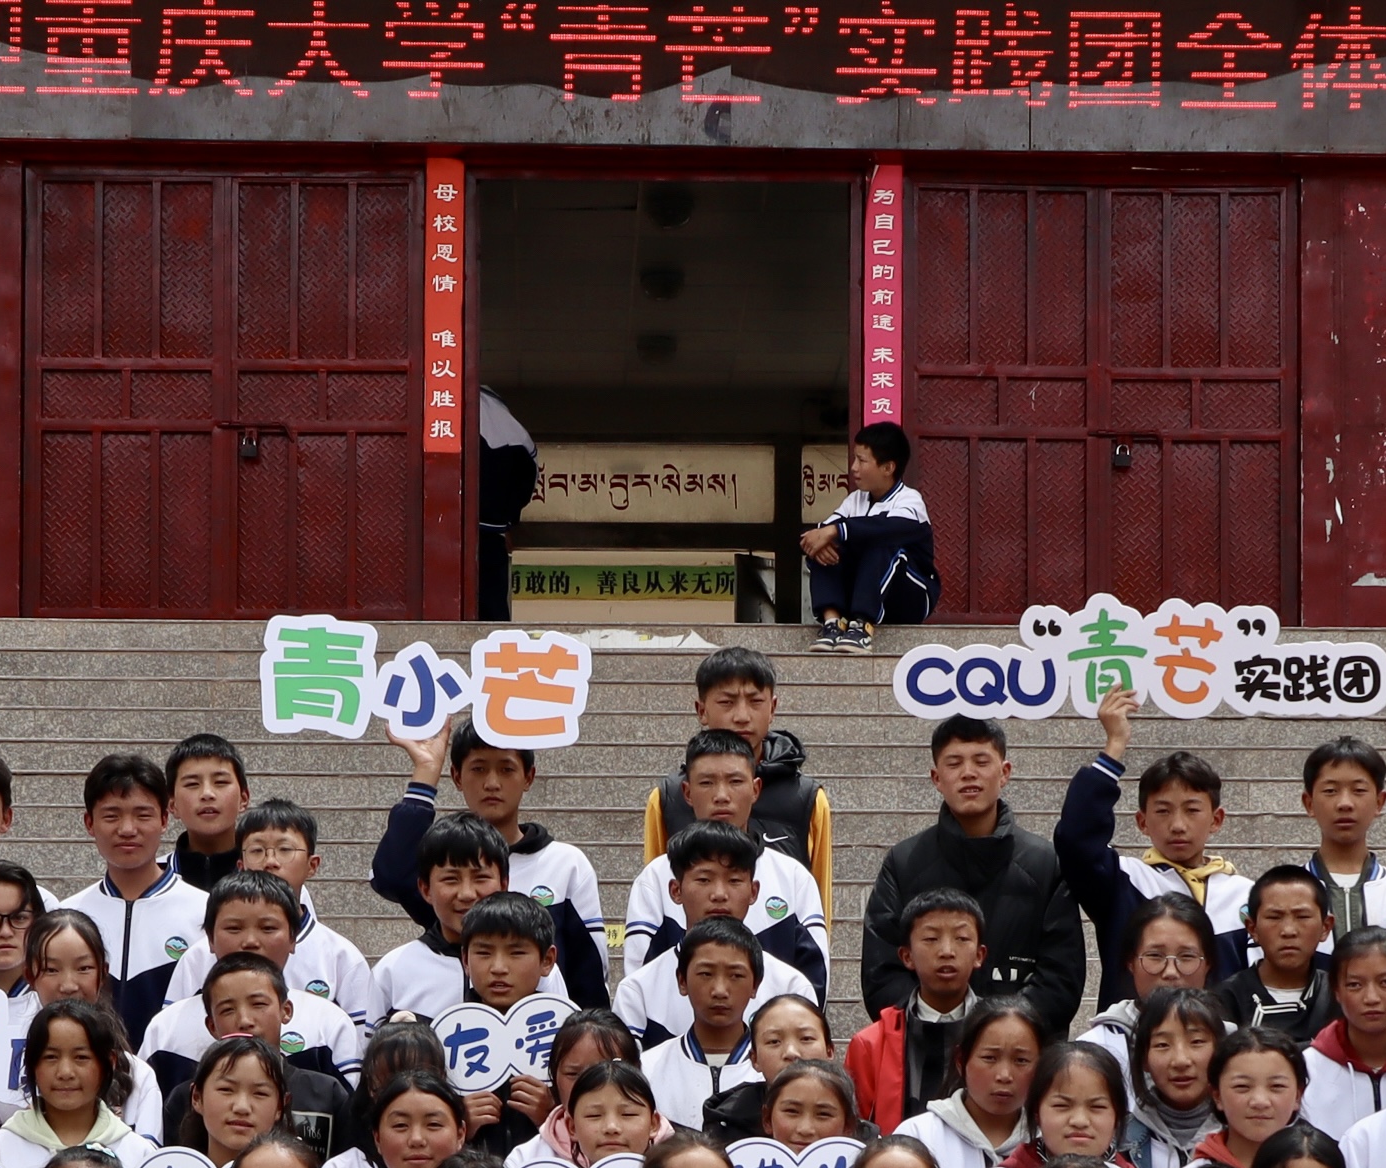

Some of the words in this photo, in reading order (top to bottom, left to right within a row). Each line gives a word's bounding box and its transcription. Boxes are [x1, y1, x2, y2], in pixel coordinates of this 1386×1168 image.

[432, 183, 459, 294] 母校恩情
[872, 189, 896, 332] 为自己的前途
[429, 329, 458, 440] 唯以胜报
[871, 347, 895, 416] 未来负
[273, 627, 580, 736] 青小芒
